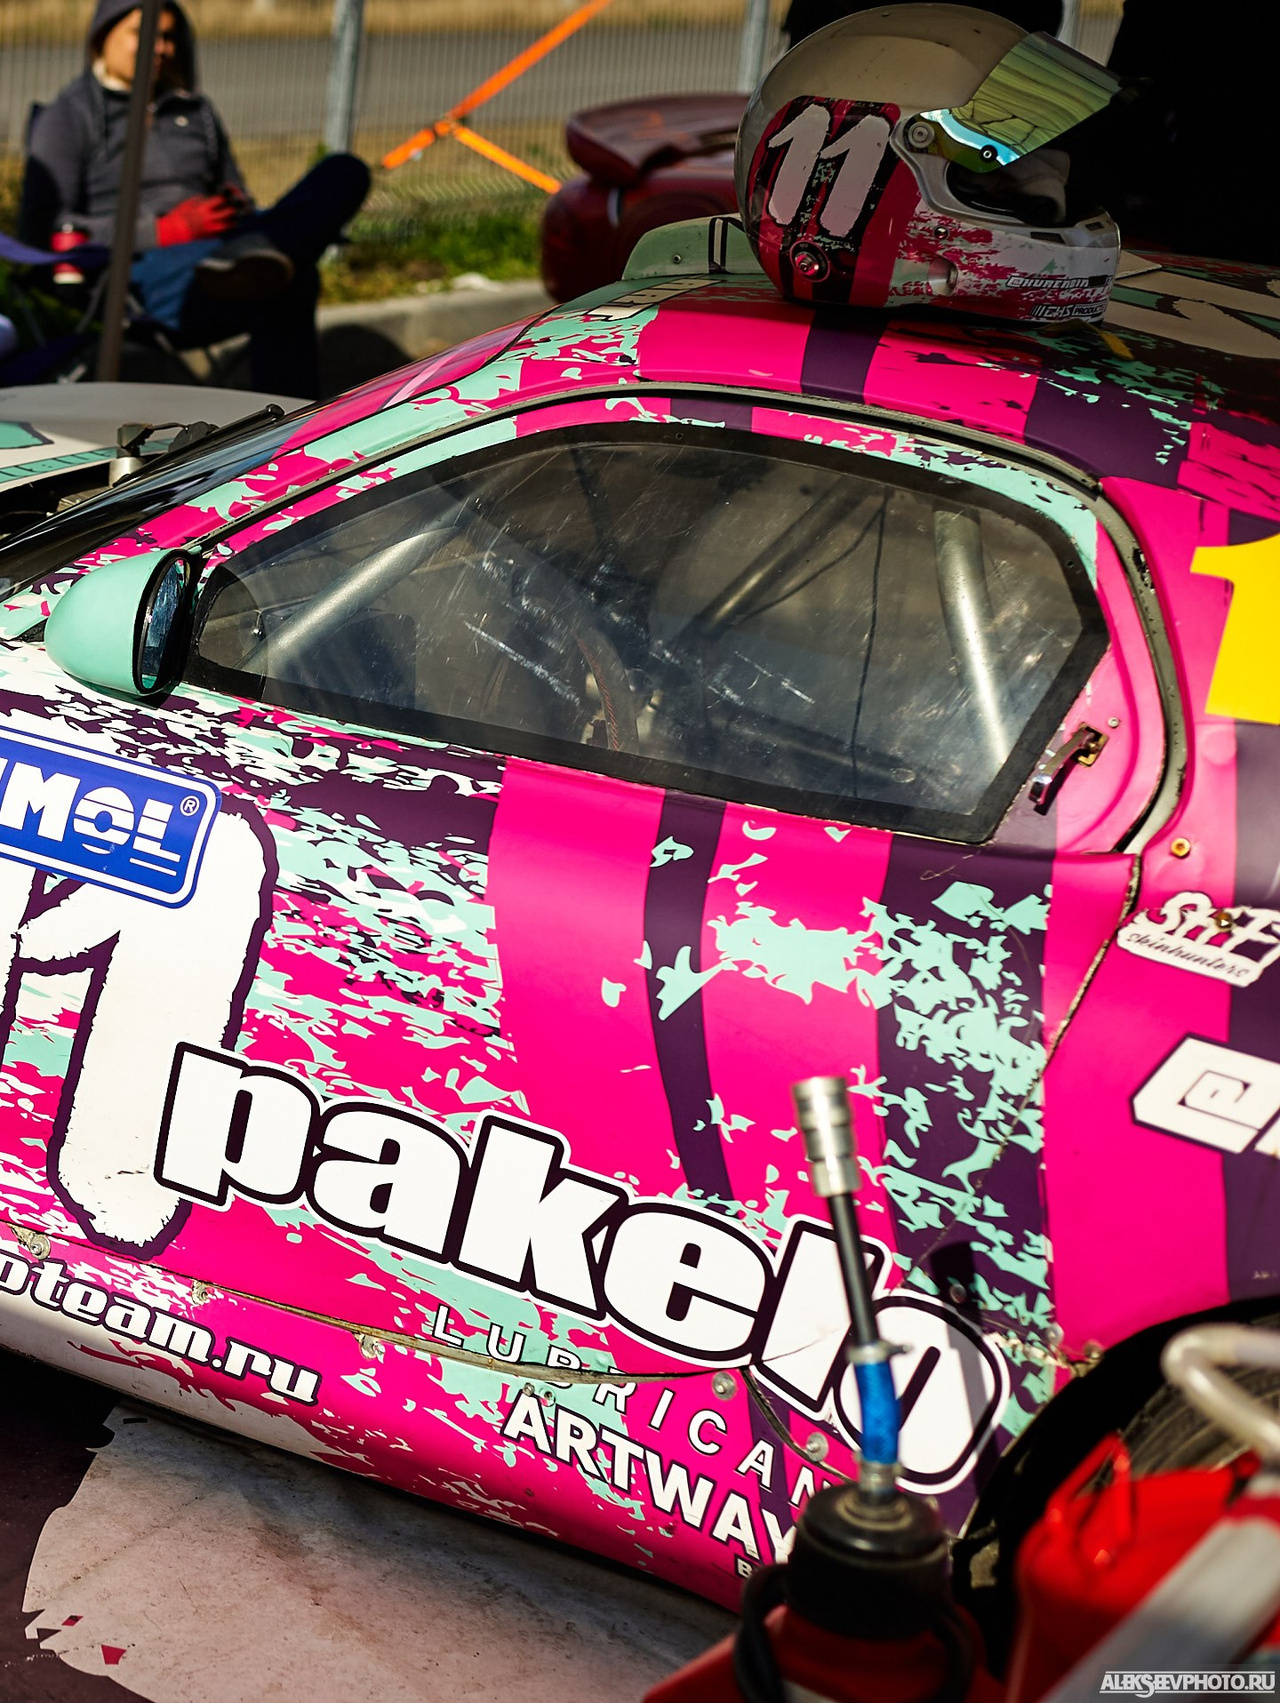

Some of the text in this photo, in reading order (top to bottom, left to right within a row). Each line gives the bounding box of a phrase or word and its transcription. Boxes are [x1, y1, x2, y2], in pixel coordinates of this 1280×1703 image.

[766, 103, 891, 238] 11
[153, 1040, 1005, 1488] pakelo
[502, 1391, 798, 1564] ARTWAY
